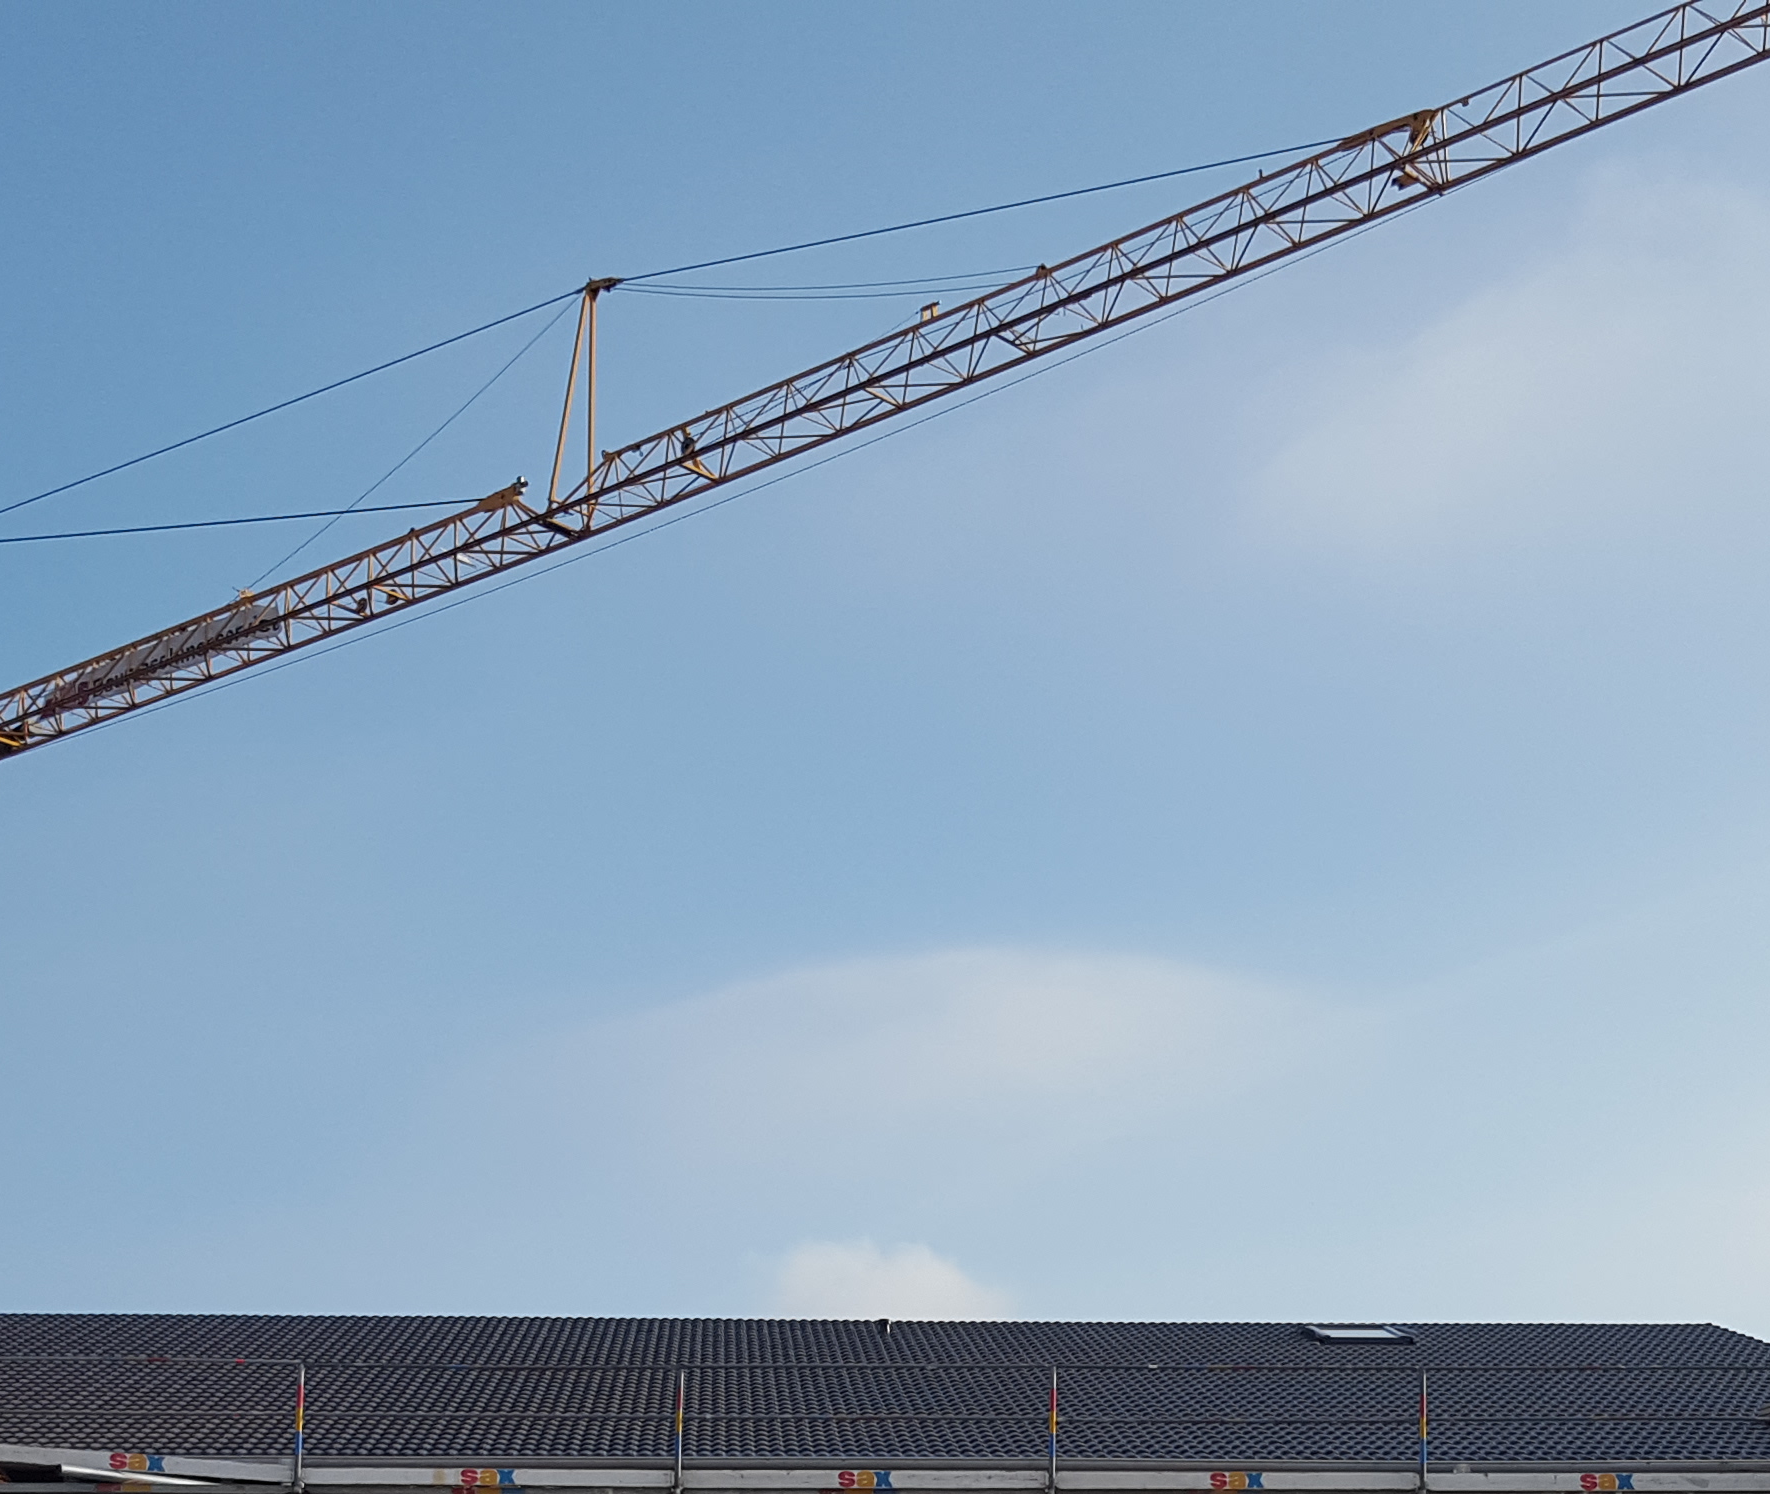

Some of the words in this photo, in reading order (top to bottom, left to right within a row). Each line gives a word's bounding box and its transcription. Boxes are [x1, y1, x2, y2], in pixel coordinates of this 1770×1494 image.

[109, 1453, 165, 1472] sax
[460, 1468, 516, 1485] sax
[838, 1470, 893, 1488] sax
[1210, 1471, 1265, 1489] sax
[1580, 1473, 1635, 1490] sax
